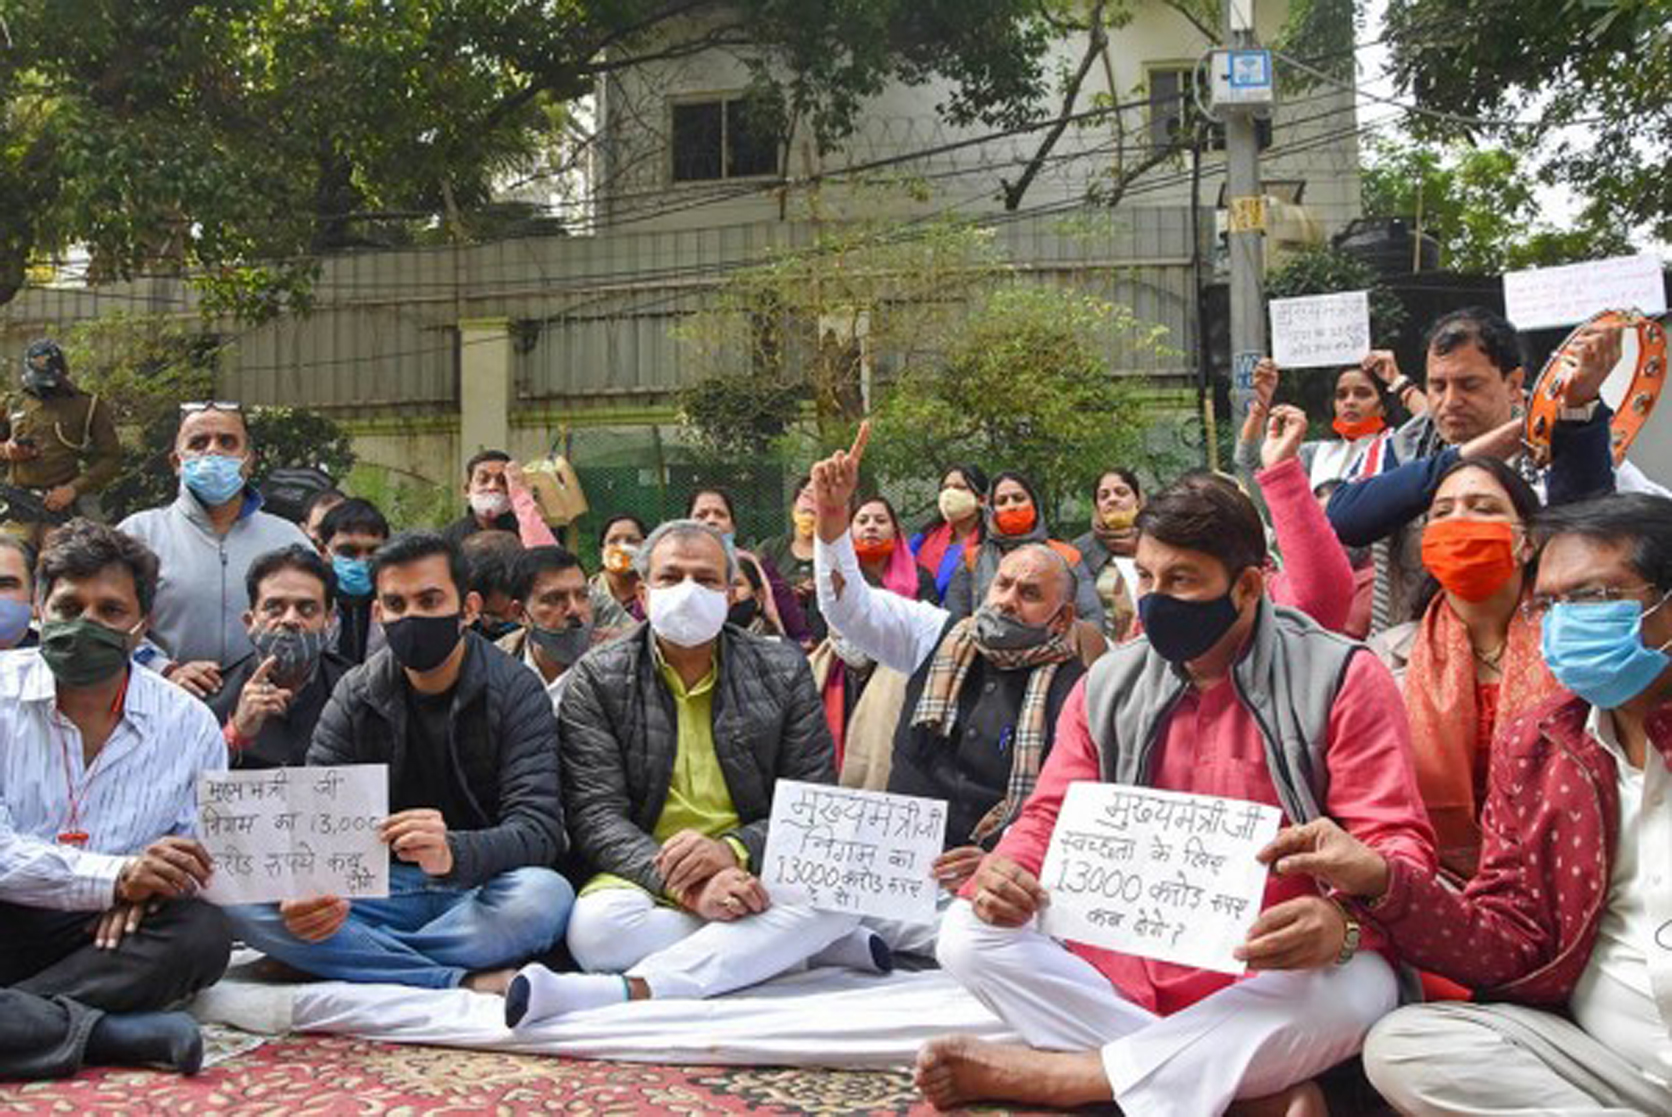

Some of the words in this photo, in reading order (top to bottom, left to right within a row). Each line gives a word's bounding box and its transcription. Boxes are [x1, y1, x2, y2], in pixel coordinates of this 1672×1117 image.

[273, 812, 302, 831] का
[801, 824, 878, 866] निगम
[888, 850, 915, 869] का
[1150, 835, 1173, 862] के
[776, 855, 840, 887] 13000
[1056, 858, 1142, 902] 13000
